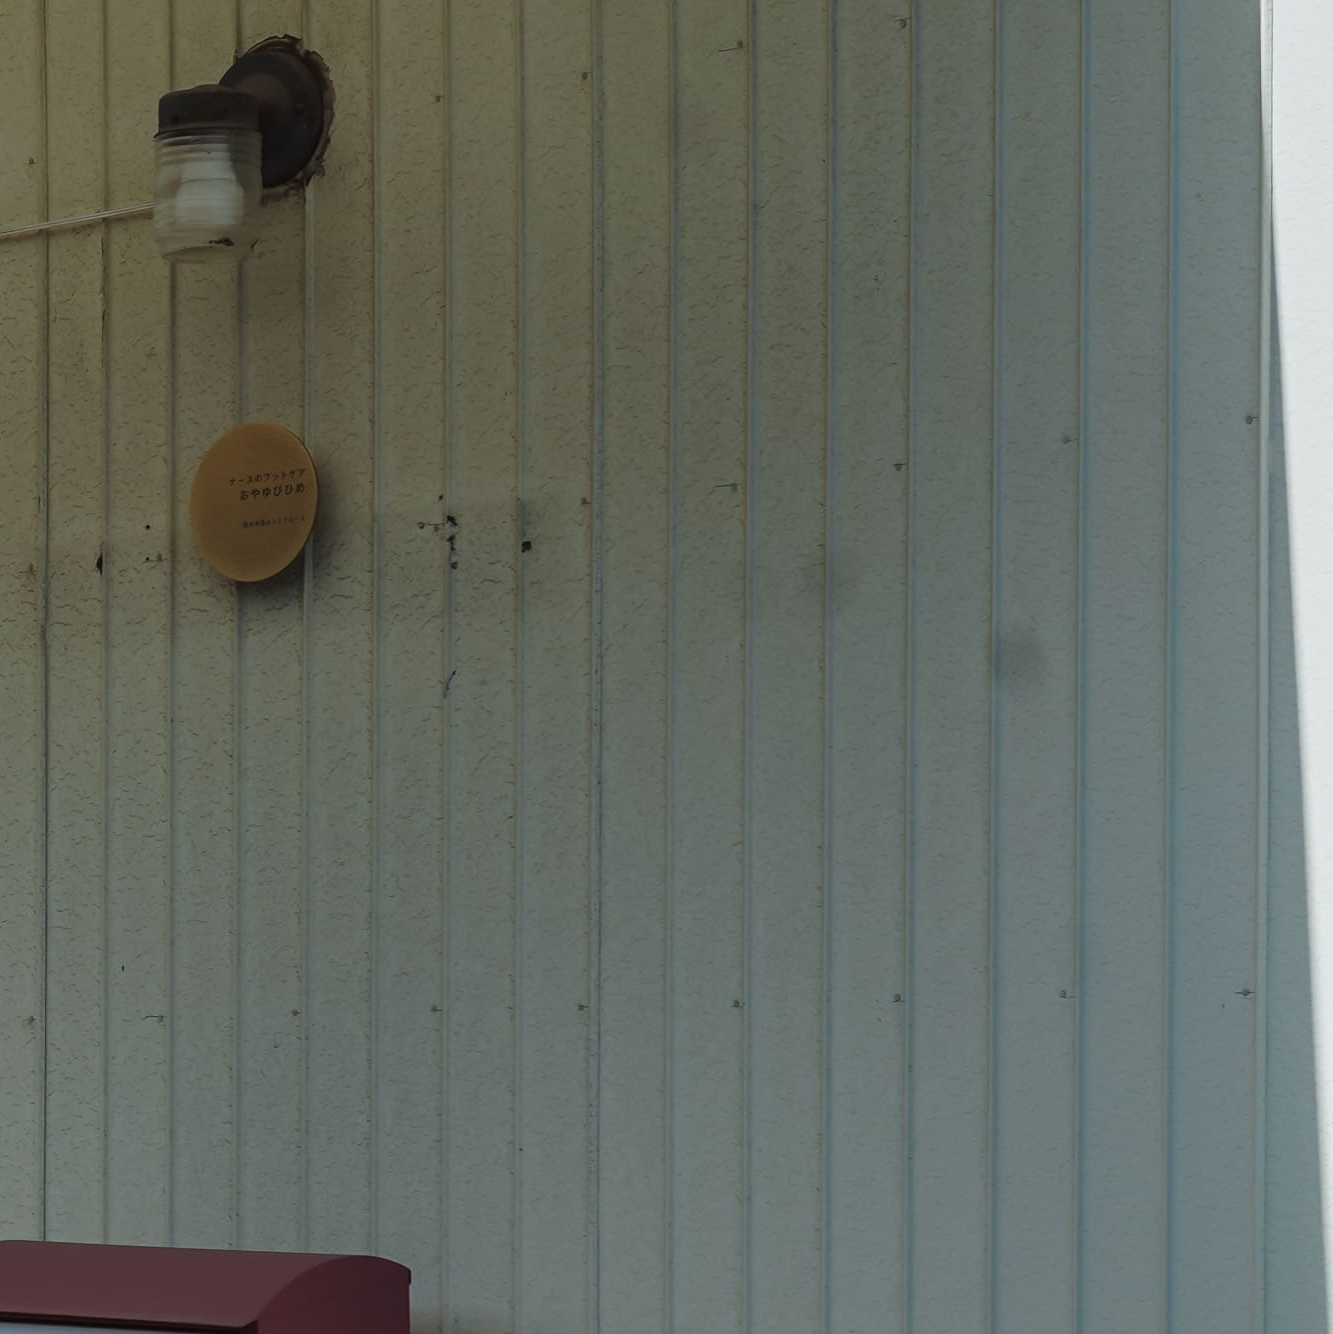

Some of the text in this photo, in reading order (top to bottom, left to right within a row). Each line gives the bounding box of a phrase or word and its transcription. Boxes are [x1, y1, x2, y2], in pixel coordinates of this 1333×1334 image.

[229, 468, 305, 486] ナースのフットケア
[240, 482, 306, 501] おやゆびひめ
